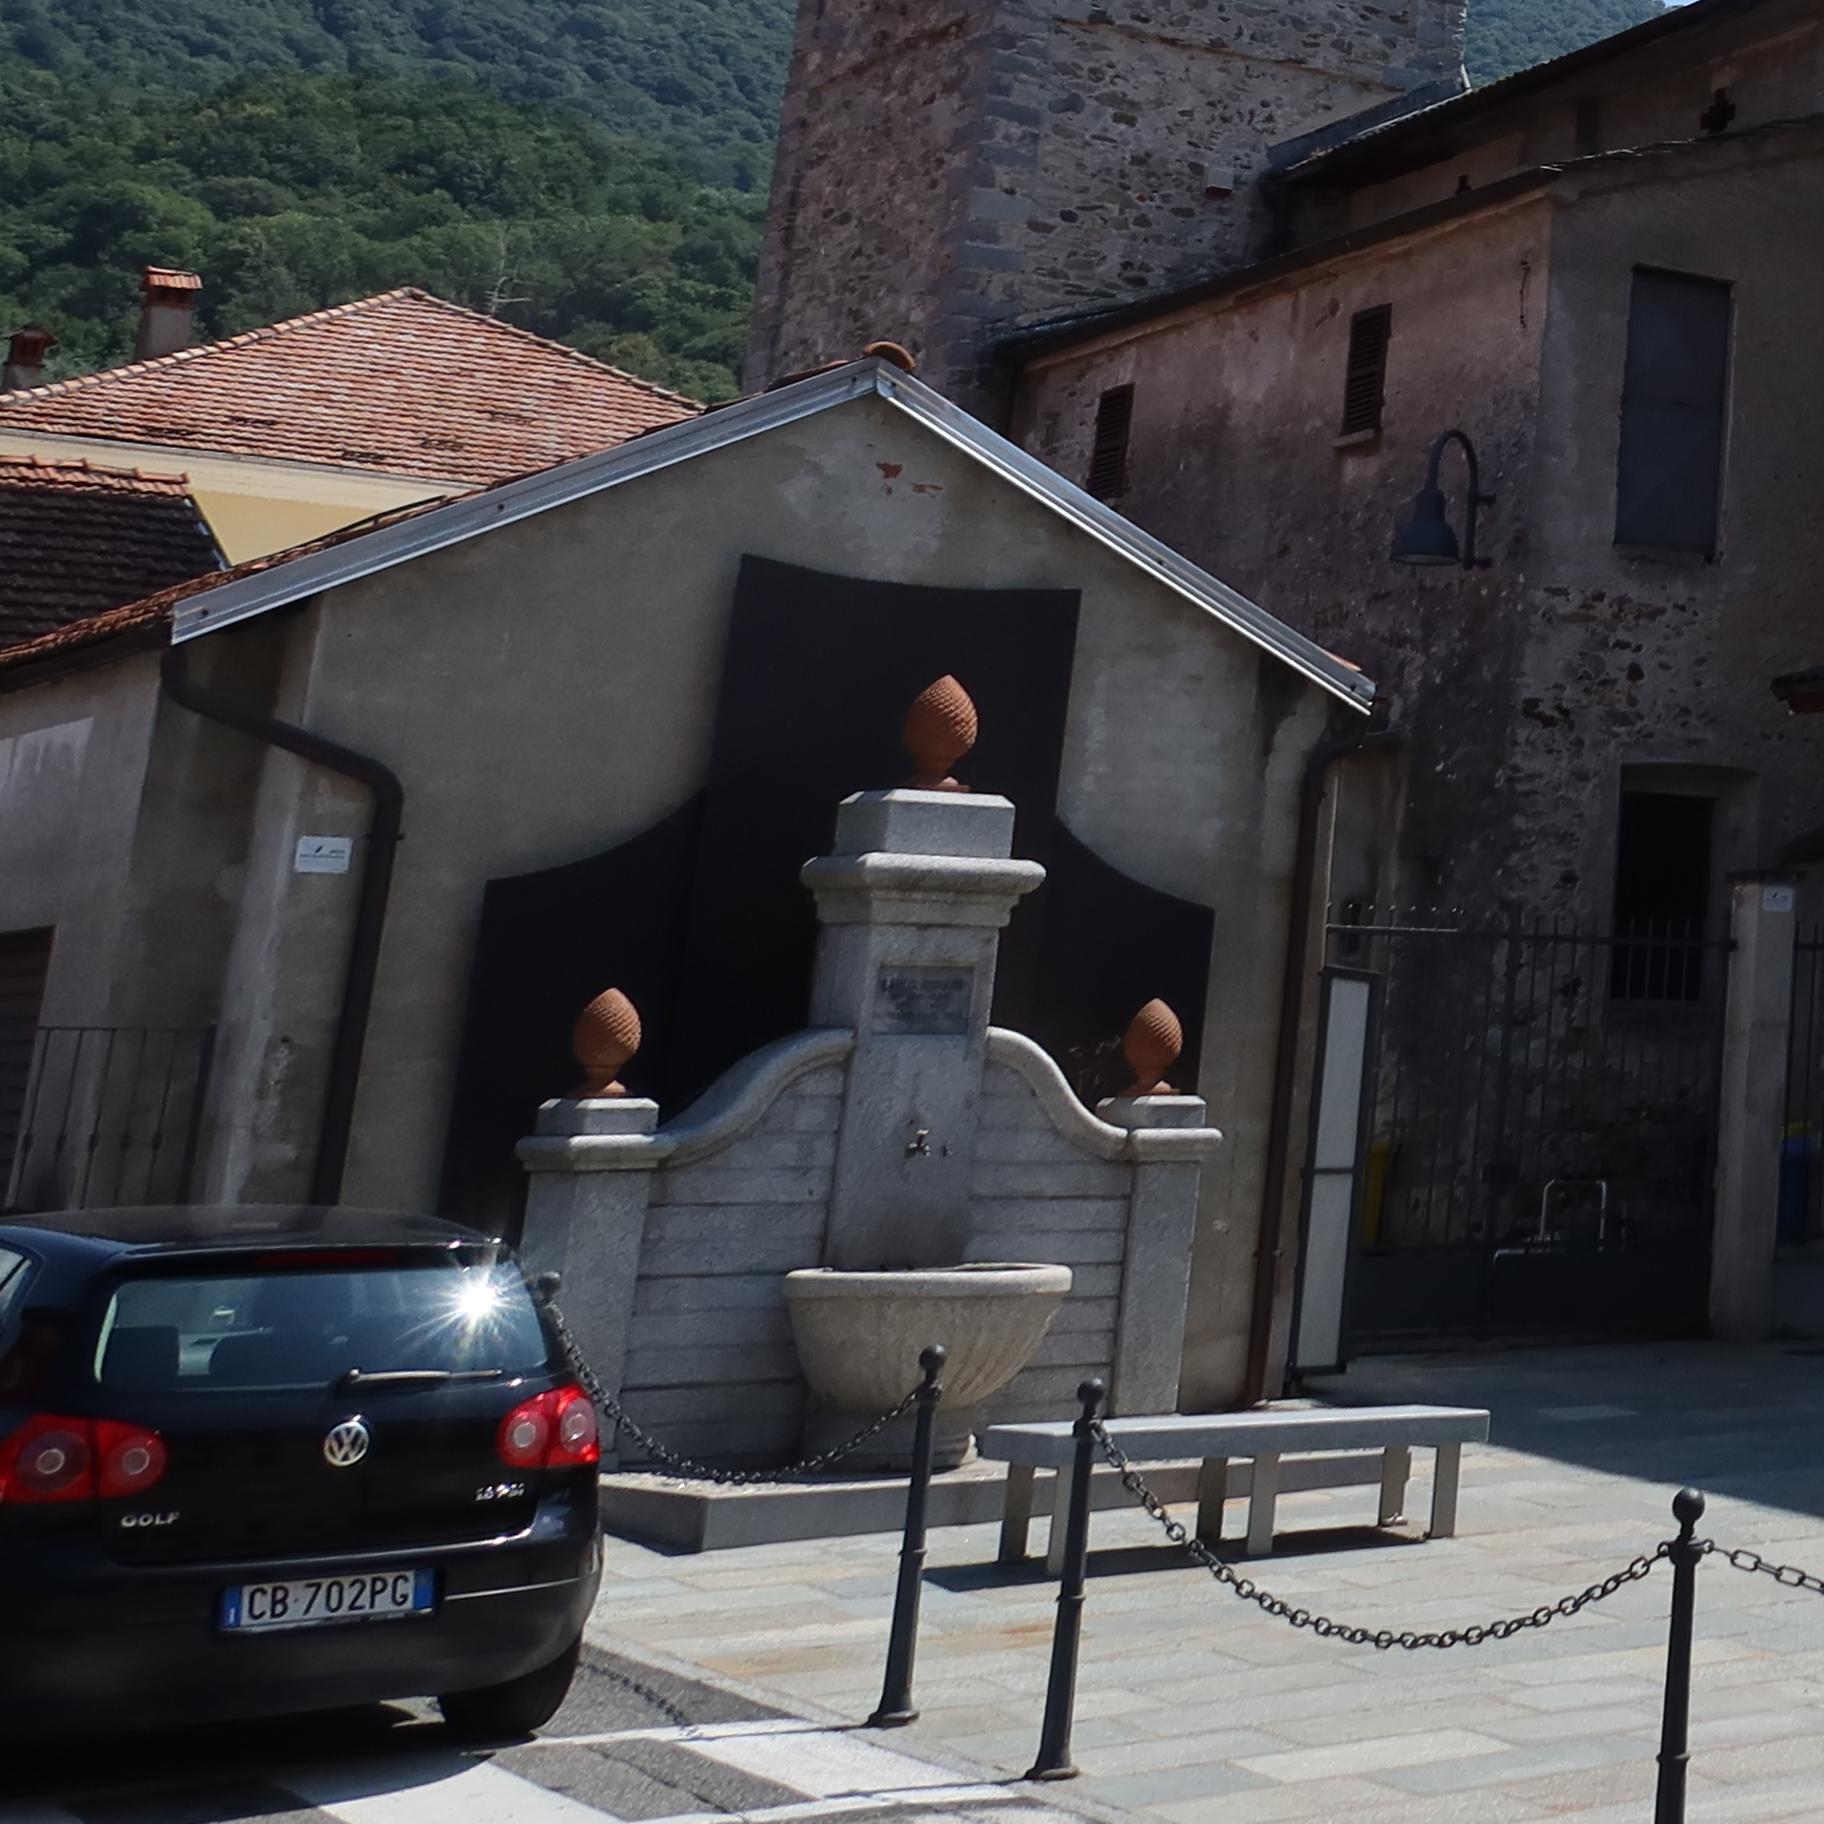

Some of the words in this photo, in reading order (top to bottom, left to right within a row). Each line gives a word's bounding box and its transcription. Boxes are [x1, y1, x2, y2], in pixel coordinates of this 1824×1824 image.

[121, 1511, 180, 1527] GOLF
[248, 1584, 289, 1620] CB
[302, 1574, 410, 1617] 702PG
